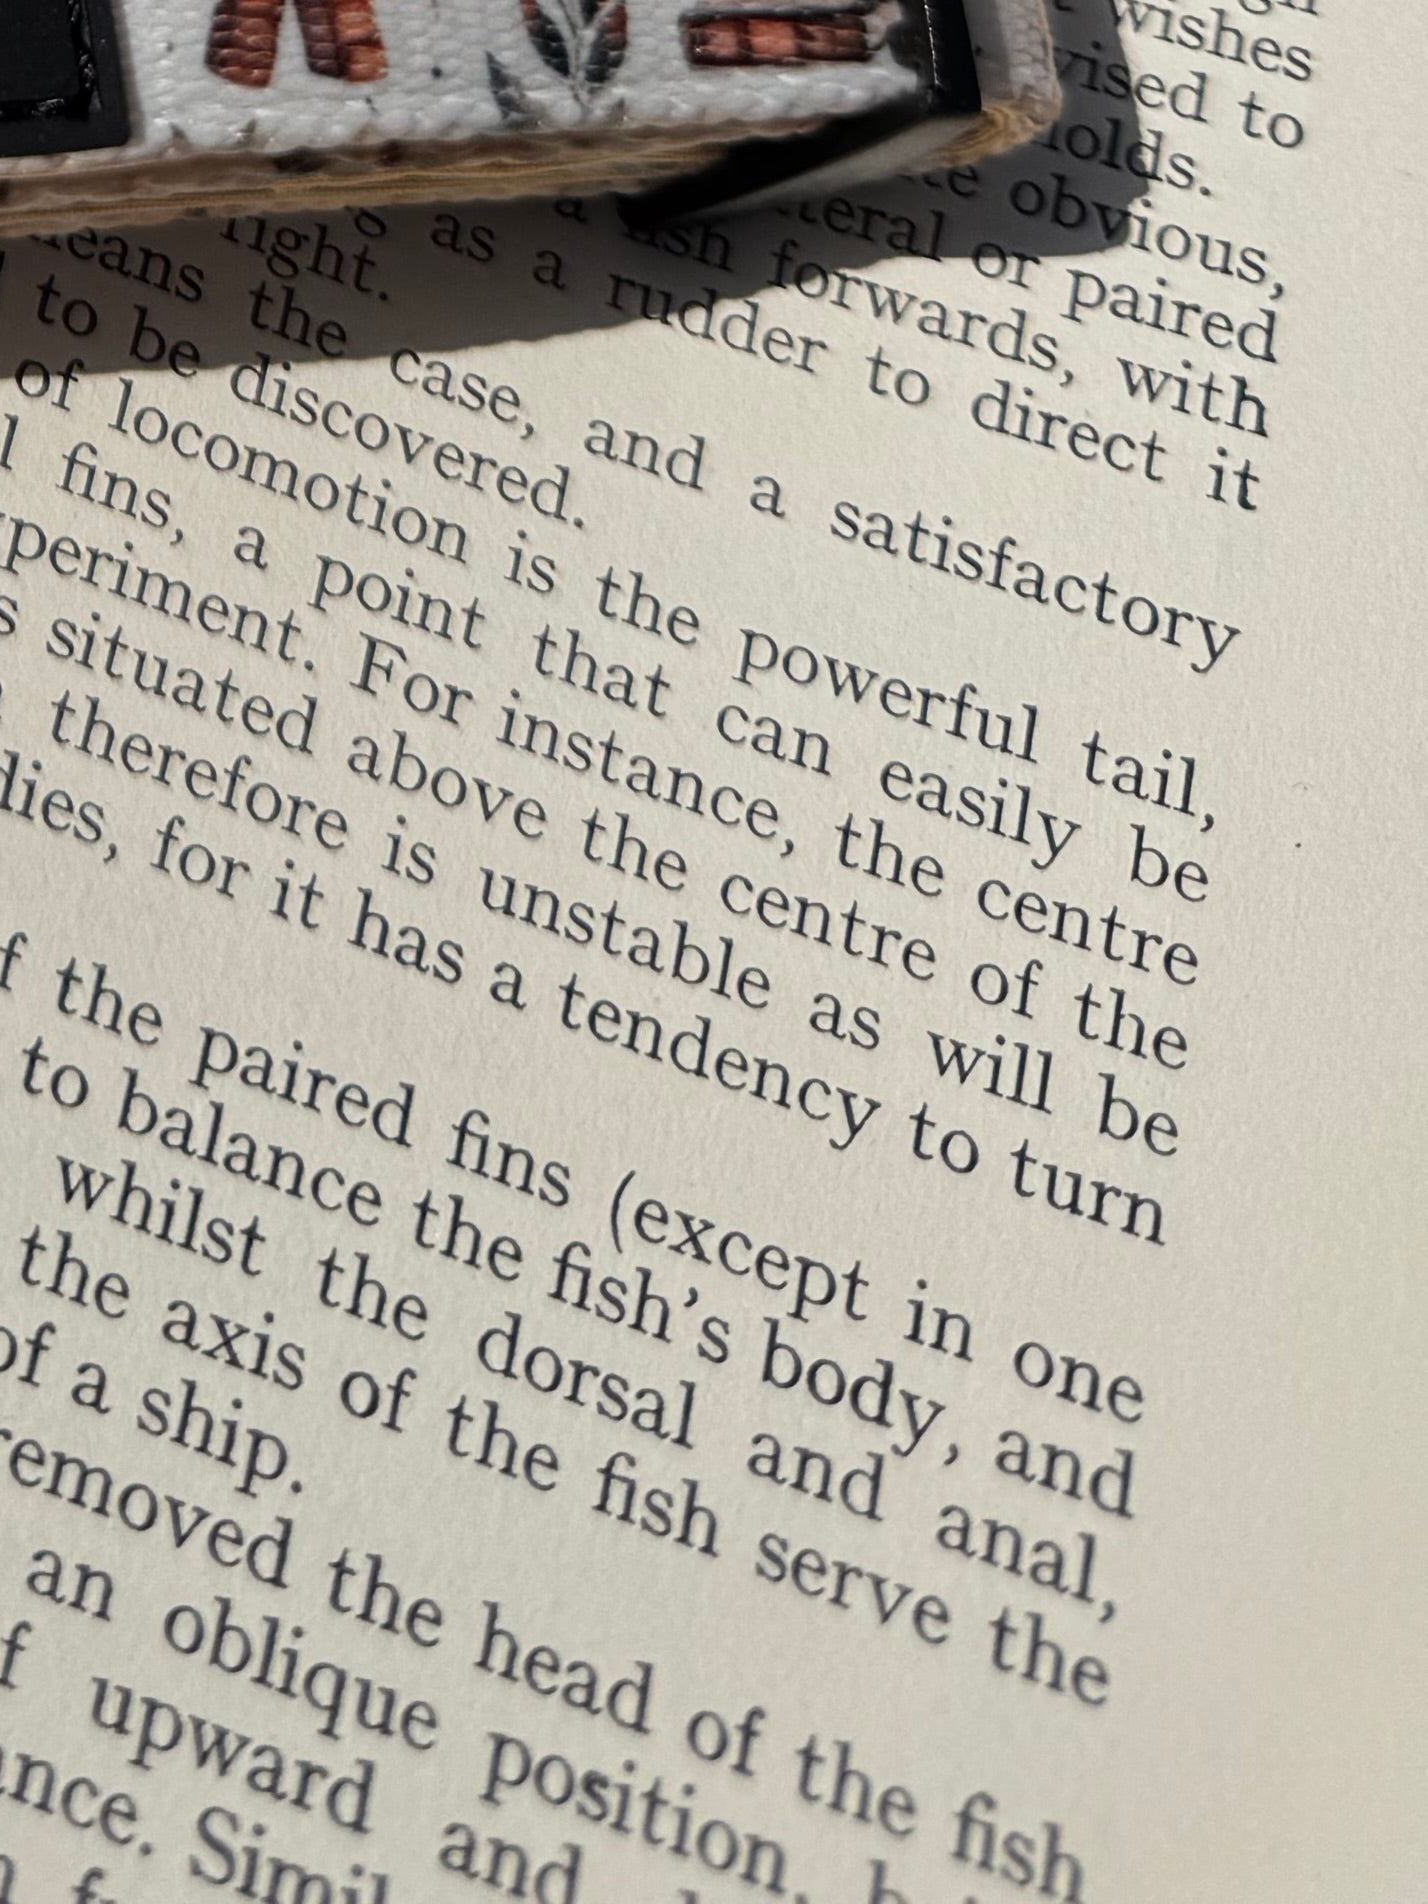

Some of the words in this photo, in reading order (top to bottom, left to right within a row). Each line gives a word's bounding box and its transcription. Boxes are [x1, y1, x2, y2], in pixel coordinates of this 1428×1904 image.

[584, 420, 705, 492] and
[750, 476, 785, 519] a
[830, 502, 1241, 674] satisfactory
[972, 379, 1167, 483] direct
[1206, 447, 1260, 511] it
[504, 530, 556, 596] is
[596, 566, 699, 648] the
[732, 629, 1037, 764] powerful
[1082, 731, 1214, 833] tail,
[56, 957, 162, 1047] the
[188, 1027, 415, 1149] paired
[446, 1109, 570, 1207] fins
[610, 1170, 869, 1323] (except
[904, 1279, 973, 1362] in
[1014, 1342, 1144, 1424] one
[57, 1155, 266, 1277] whilst
[318, 1247, 428, 1341] the
[478, 1311, 696, 1450] dorsal
[747, 1433, 884, 1522] and
[936, 1505, 1115, 1624] anal,
[328, 1548, 443, 1648] the
[474, 1601, 653, 1735] head
[687, 1707, 766, 1777] of
[797, 1735, 915, 1838] the
